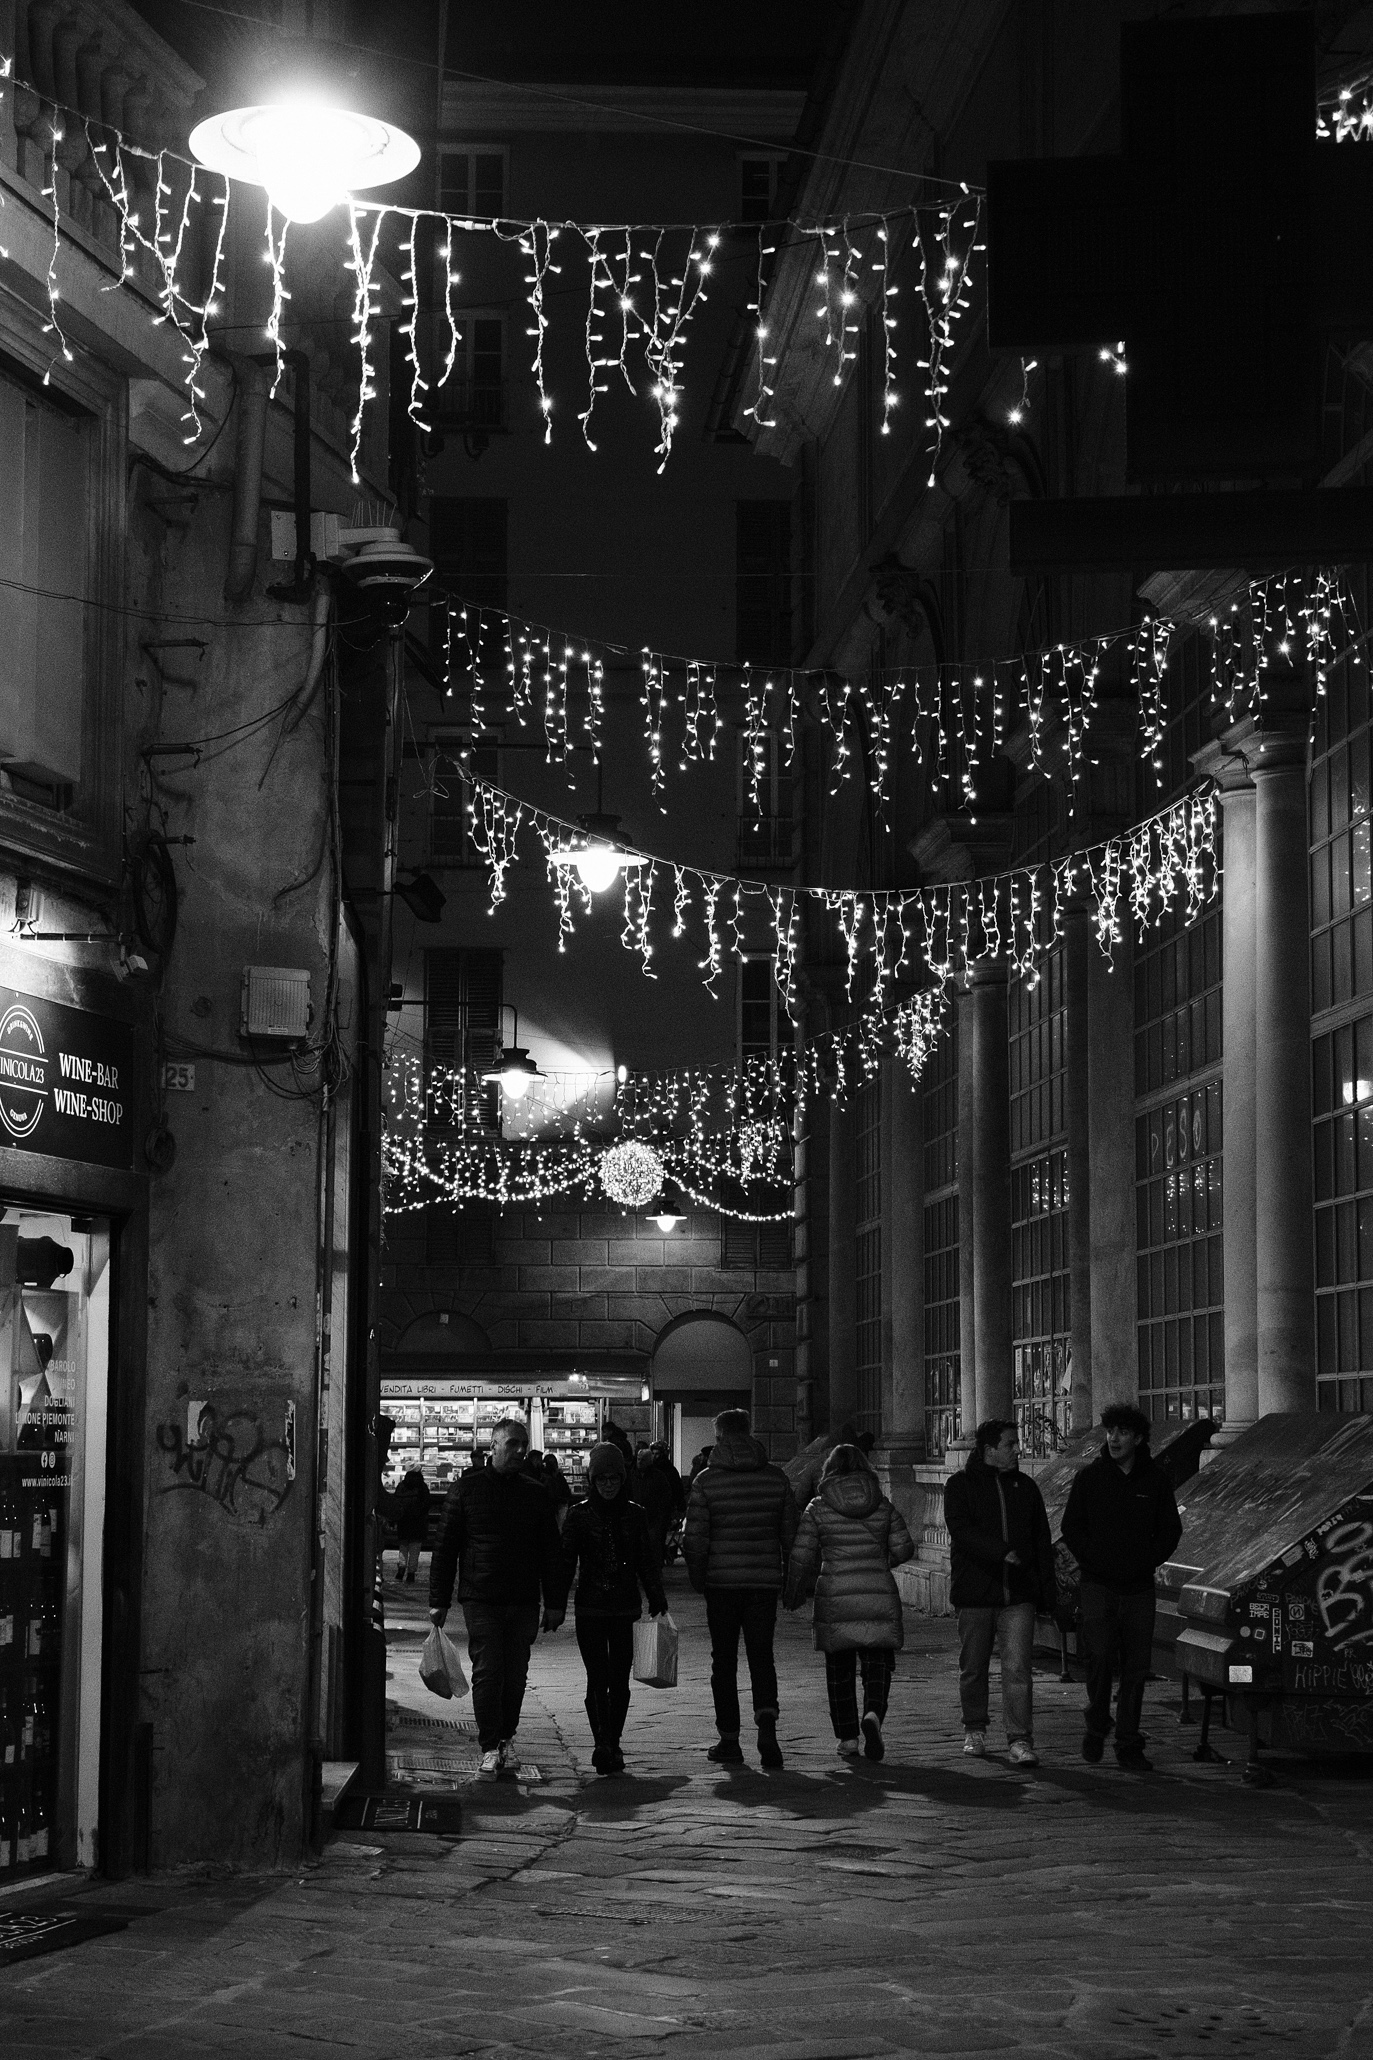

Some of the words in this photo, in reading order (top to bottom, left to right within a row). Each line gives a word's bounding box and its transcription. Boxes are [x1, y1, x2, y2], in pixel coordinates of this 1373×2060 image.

[0, 1057, 44, 1083] INICOLA23
[59, 1052, 119, 1089] WINE-BAR
[166, 1066, 189, 1088] 25
[54, 1088, 123, 1125] WINE-SHOP
[50, 1360, 76, 1372] BAROLO
[417, 1384, 436, 1394] LIBRI
[450, 1385, 484, 1394] FUMETTI
[497, 1385, 522, 1394] DISCHI
[536, 1385, 553, 1394] FILM
[45, 1395, 75, 1407] DOGLIANI
[15, 1411, 41, 1425] LONE
[42, 1412, 75, 1426] PIEMONTE
[54, 1431, 75, 1443] NARNI
[21, 1475, 71, 1487] www.vinicola23.i
